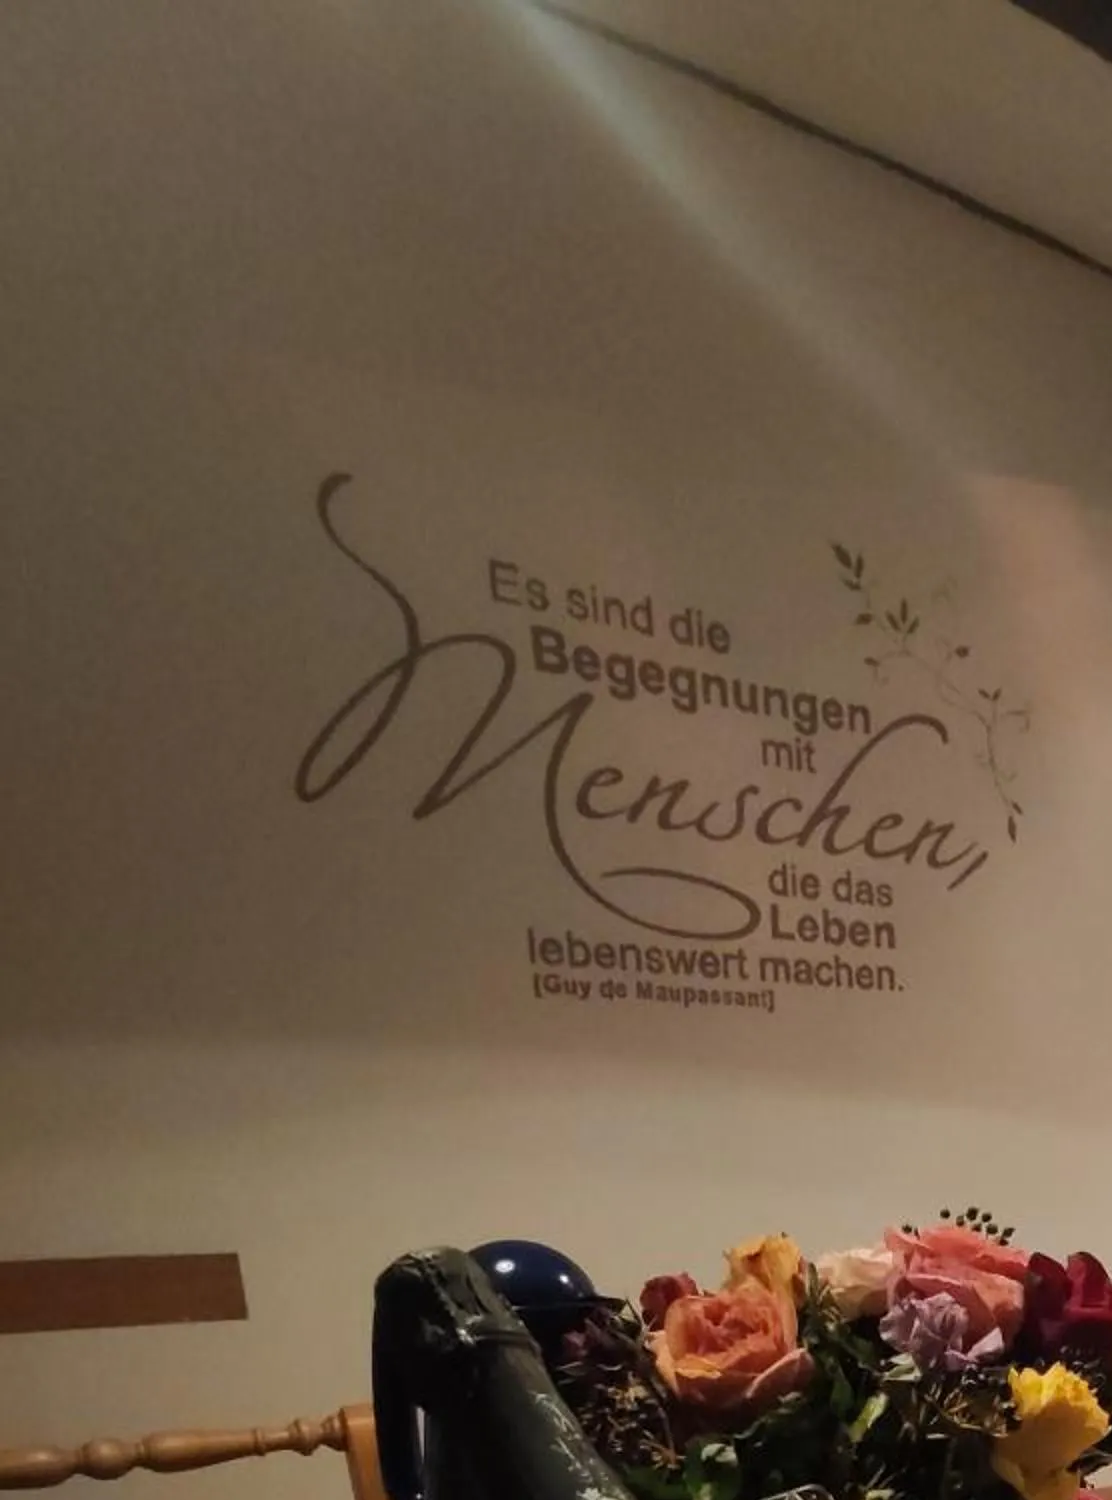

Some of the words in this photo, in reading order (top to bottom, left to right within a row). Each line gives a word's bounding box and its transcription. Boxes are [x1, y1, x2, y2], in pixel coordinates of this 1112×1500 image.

[489, 558, 550, 612] Es
[566, 584, 654, 638] sind
[668, 607, 731, 654] die
[530, 625, 872, 735] Begegnungen
[761, 735, 816, 774] mit
[767, 863, 821, 900] die
[832, 869, 894, 908] das
[769, 903, 896, 950] Leben
[527, 926, 749, 982] lebenswert
[758, 954, 905, 993] machen.
[600, 979, 628, 1001] de
